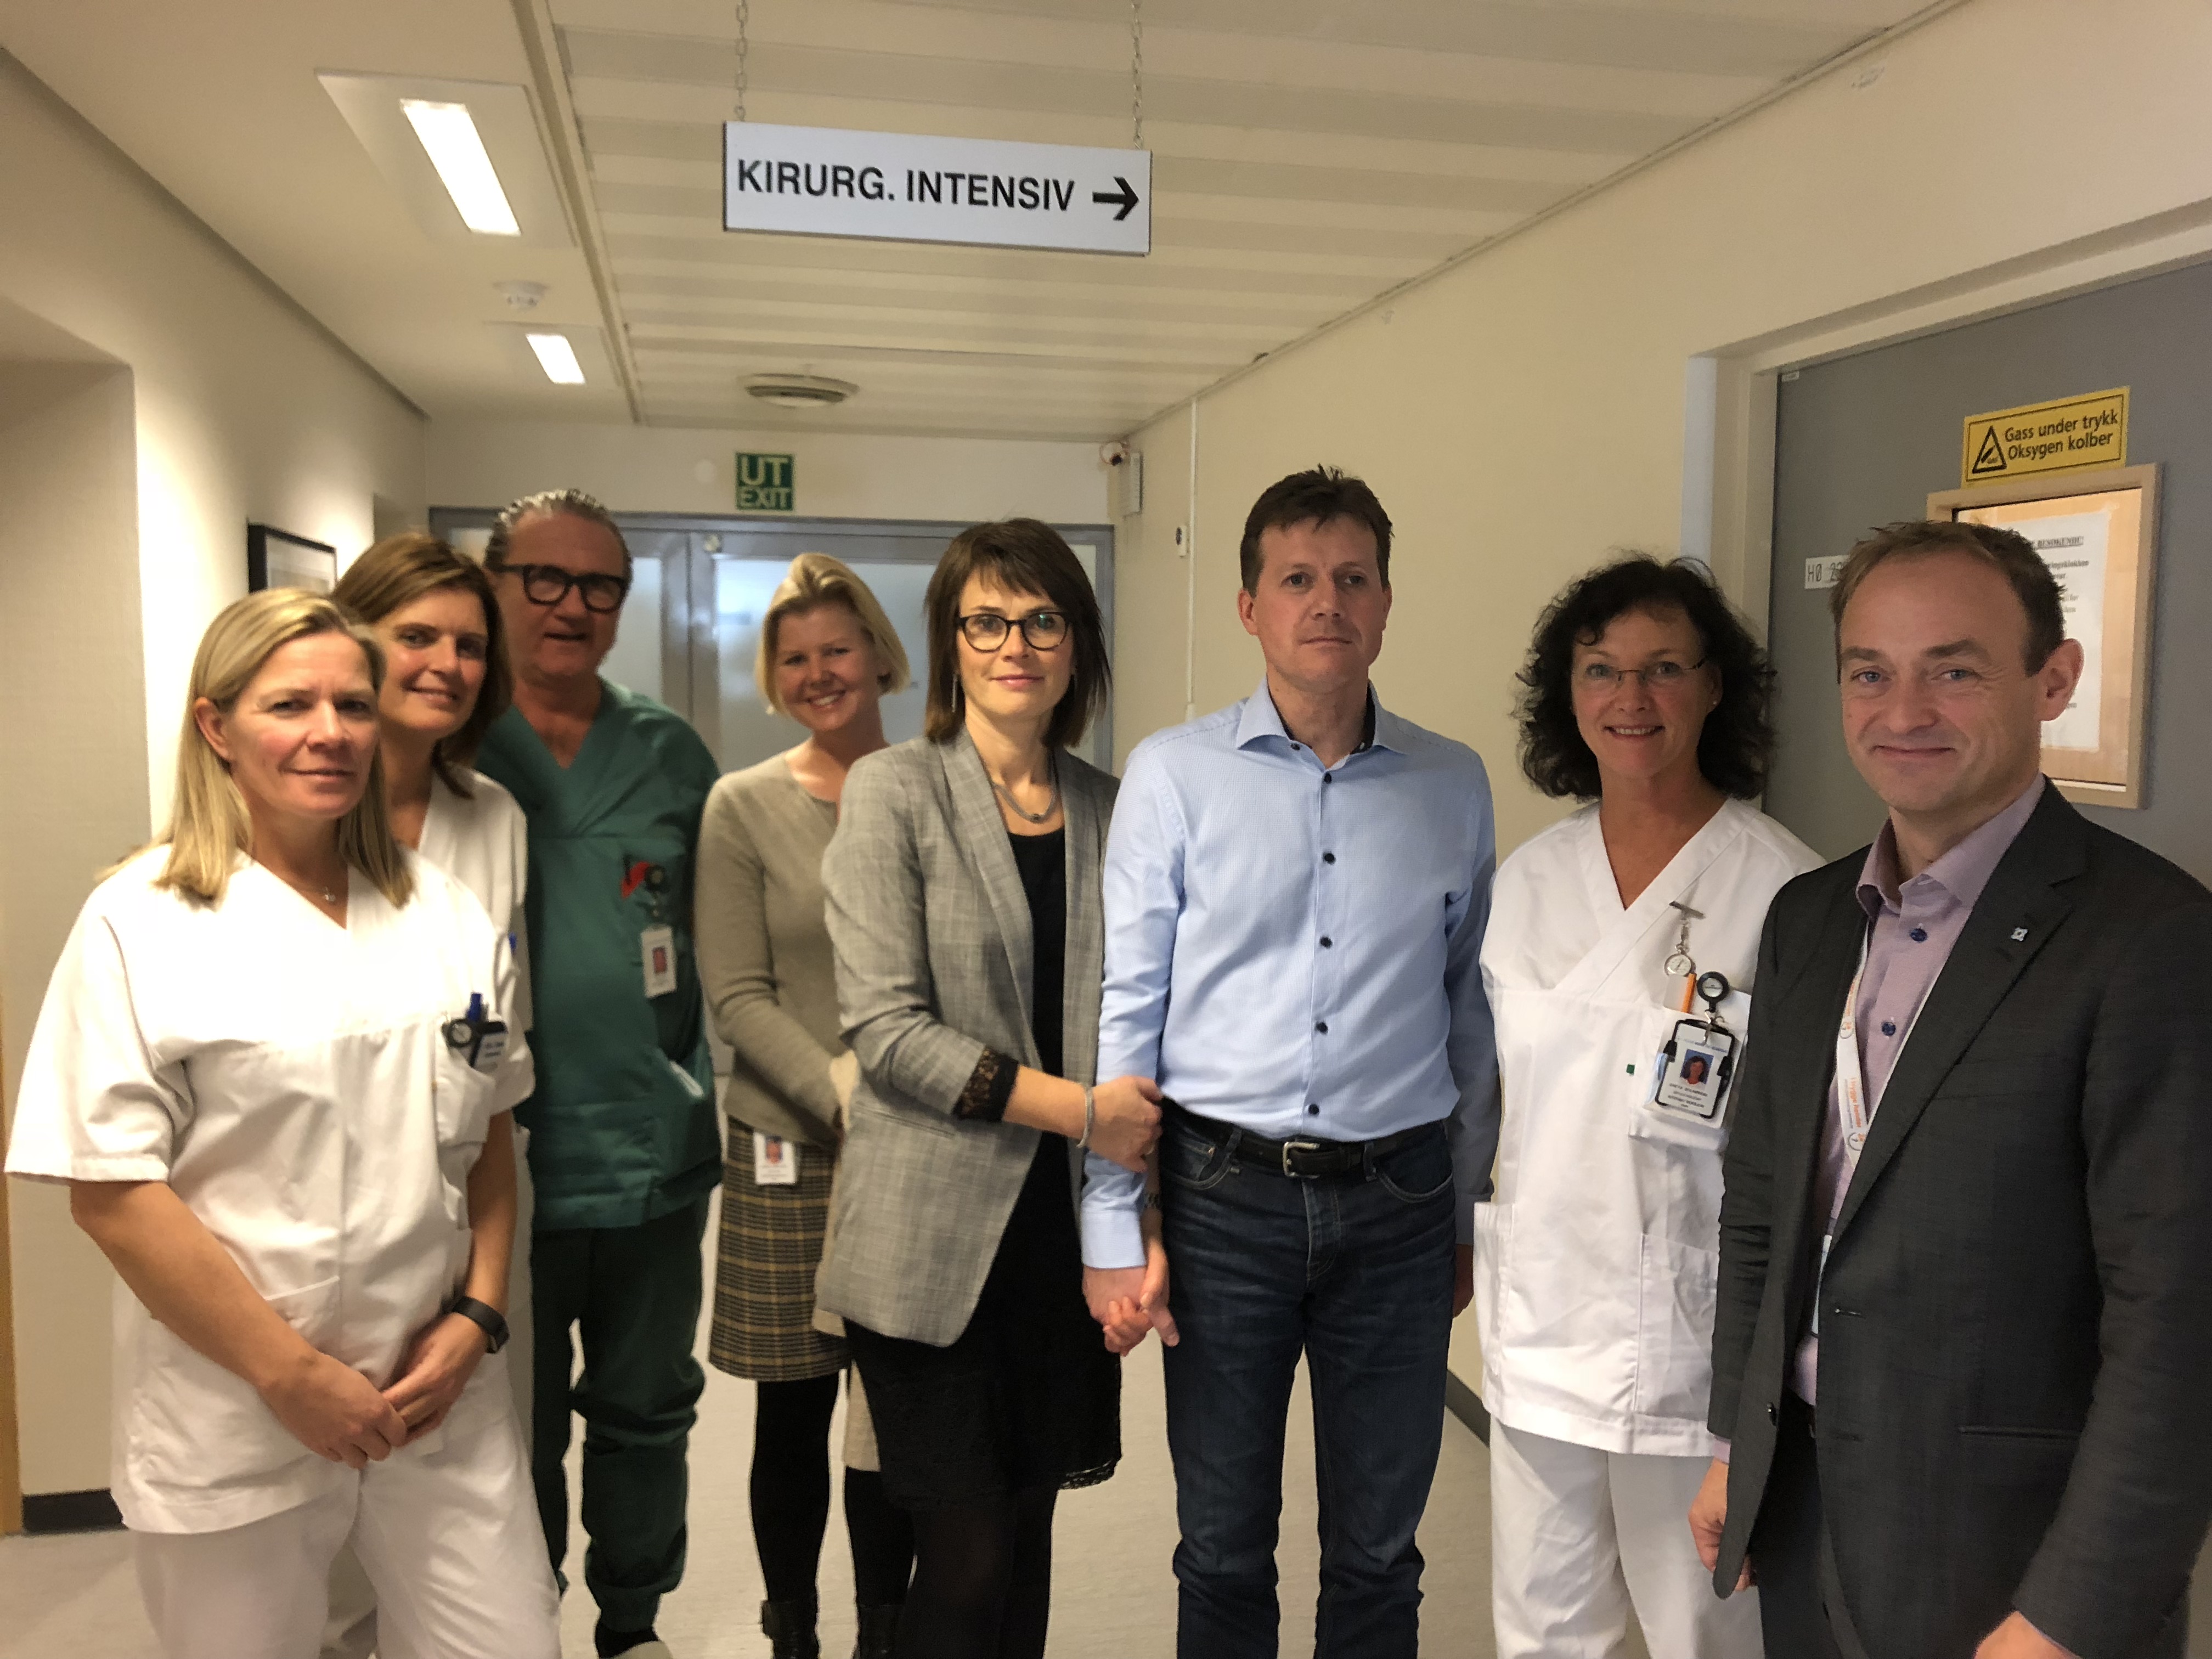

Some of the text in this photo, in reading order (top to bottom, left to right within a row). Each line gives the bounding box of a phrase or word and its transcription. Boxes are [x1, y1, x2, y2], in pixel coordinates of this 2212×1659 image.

[738, 159, 1075, 212] KIRURG. INTENSIV
[2005, 409, 2118, 442] Gass under trykk
[2008, 432, 2113, 461] Oksygen kolber
[741, 456, 789, 486] UT
[739, 486, 791, 508] EXIT
